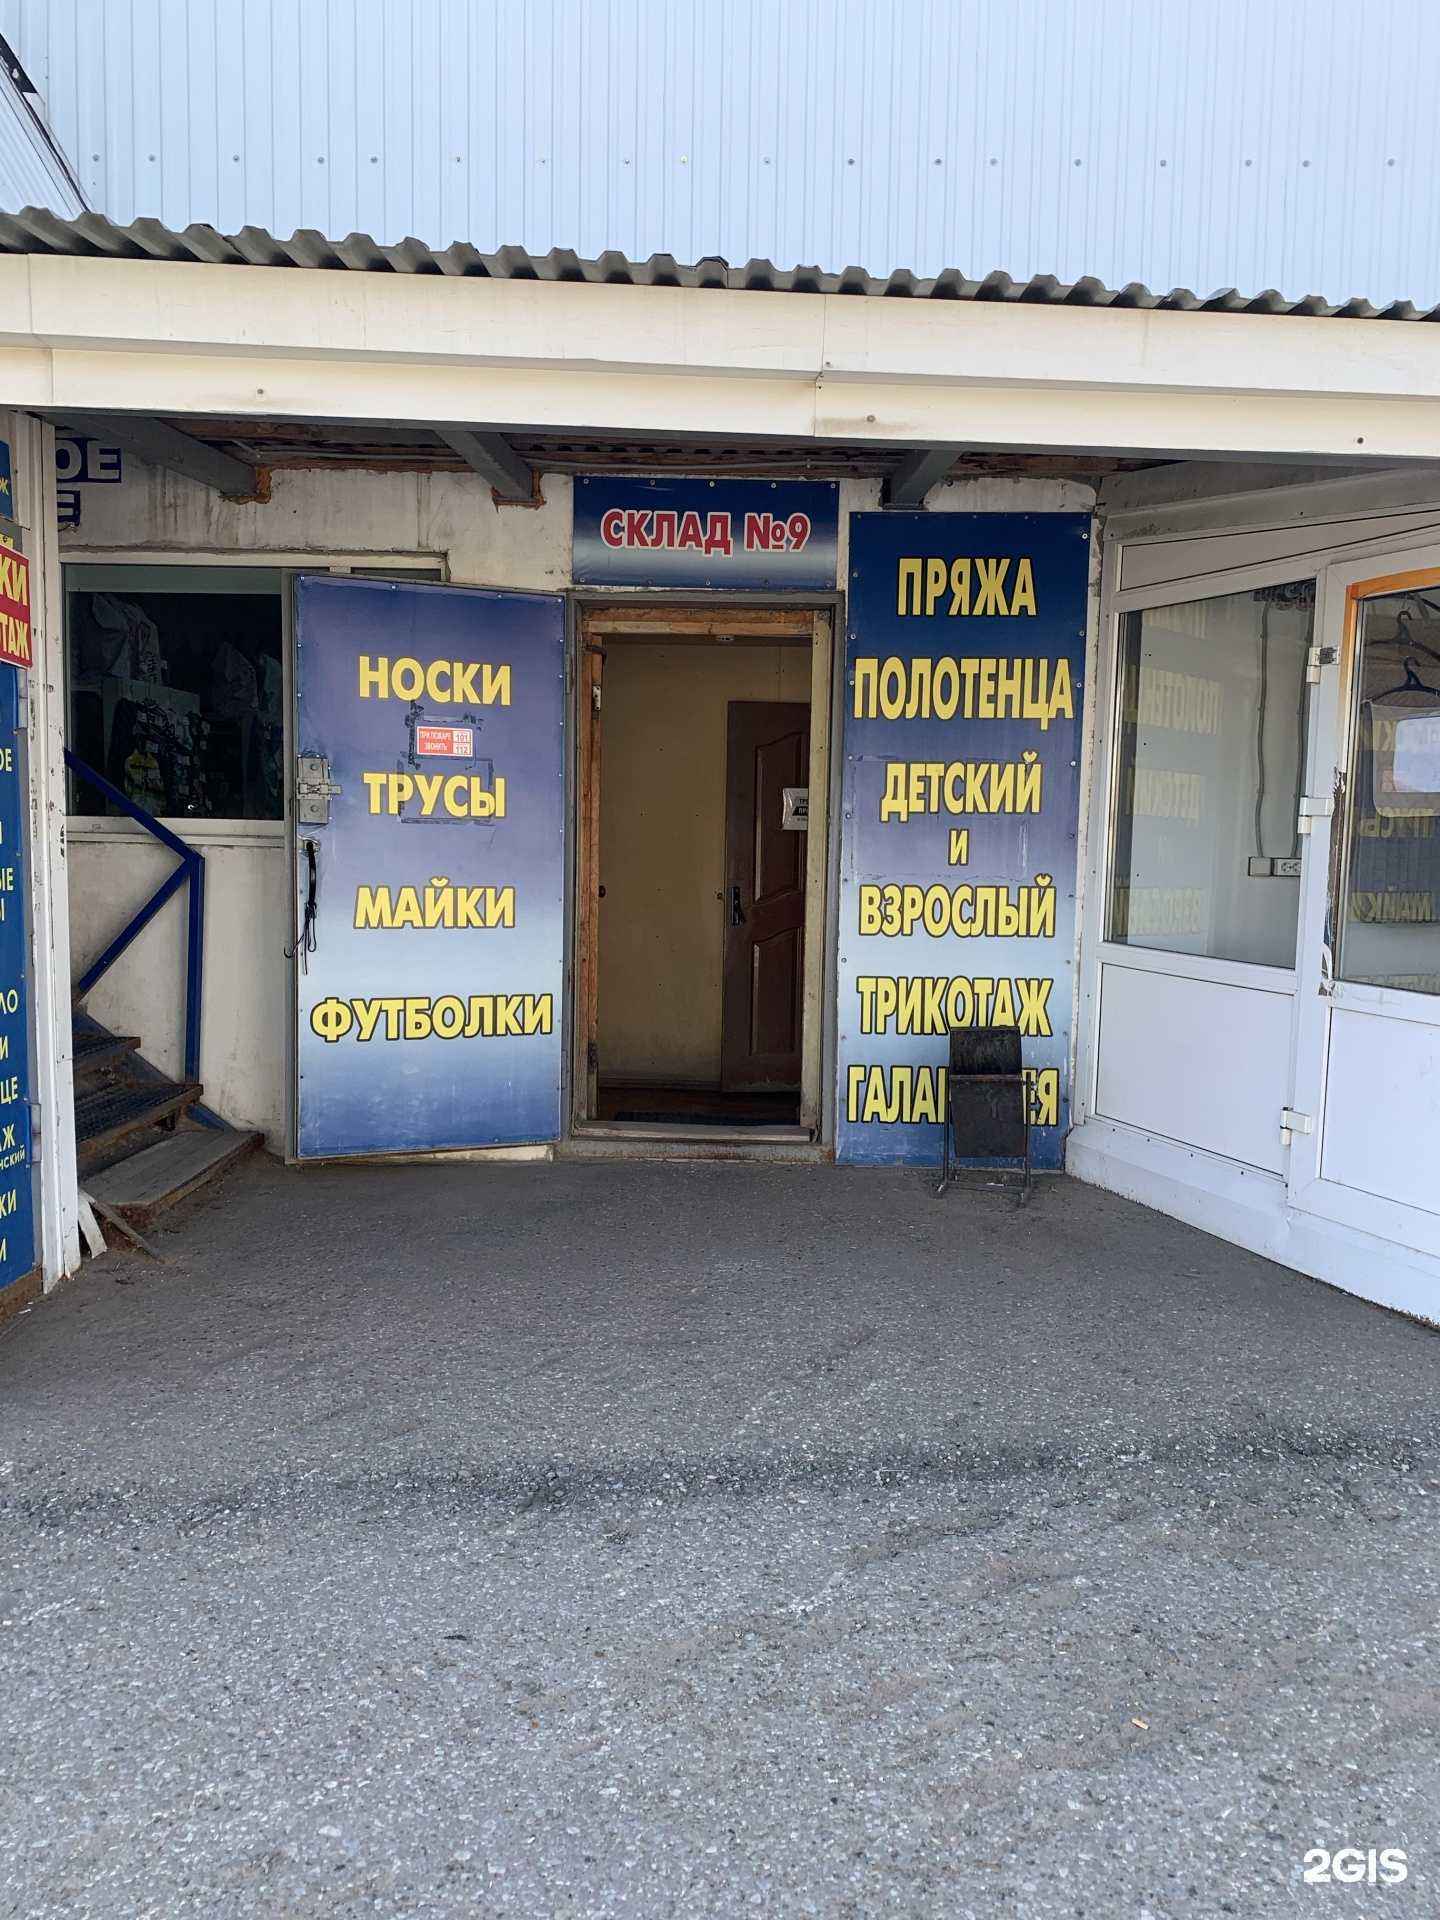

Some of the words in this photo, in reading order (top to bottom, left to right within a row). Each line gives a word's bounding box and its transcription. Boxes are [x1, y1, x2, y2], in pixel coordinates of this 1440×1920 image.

[601, 509, 733, 556] СКЛАД
[745, 513, 811, 552] №9
[897, 557, 1037, 616] ПРЯЖА
[358, 655, 511, 706] НОСКИ
[853, 656, 1075, 731] ПОЛОТЕНЦА
[363, 772, 506, 817] ТРУСЫ
[880, 750, 1043, 822] ДЕТСКИЙ
[948, 829, 968, 865] И
[354, 876, 515, 929] МАЙКИ
[858, 874, 1056, 937] ВЗРОСЛЫЙ
[310, 993, 553, 1042] ФУТБОЛКИ
[856, 976, 1053, 1036] ТРИКОТАЖ
[847, 1065, 1059, 1126] ГАЛАЕЯ
